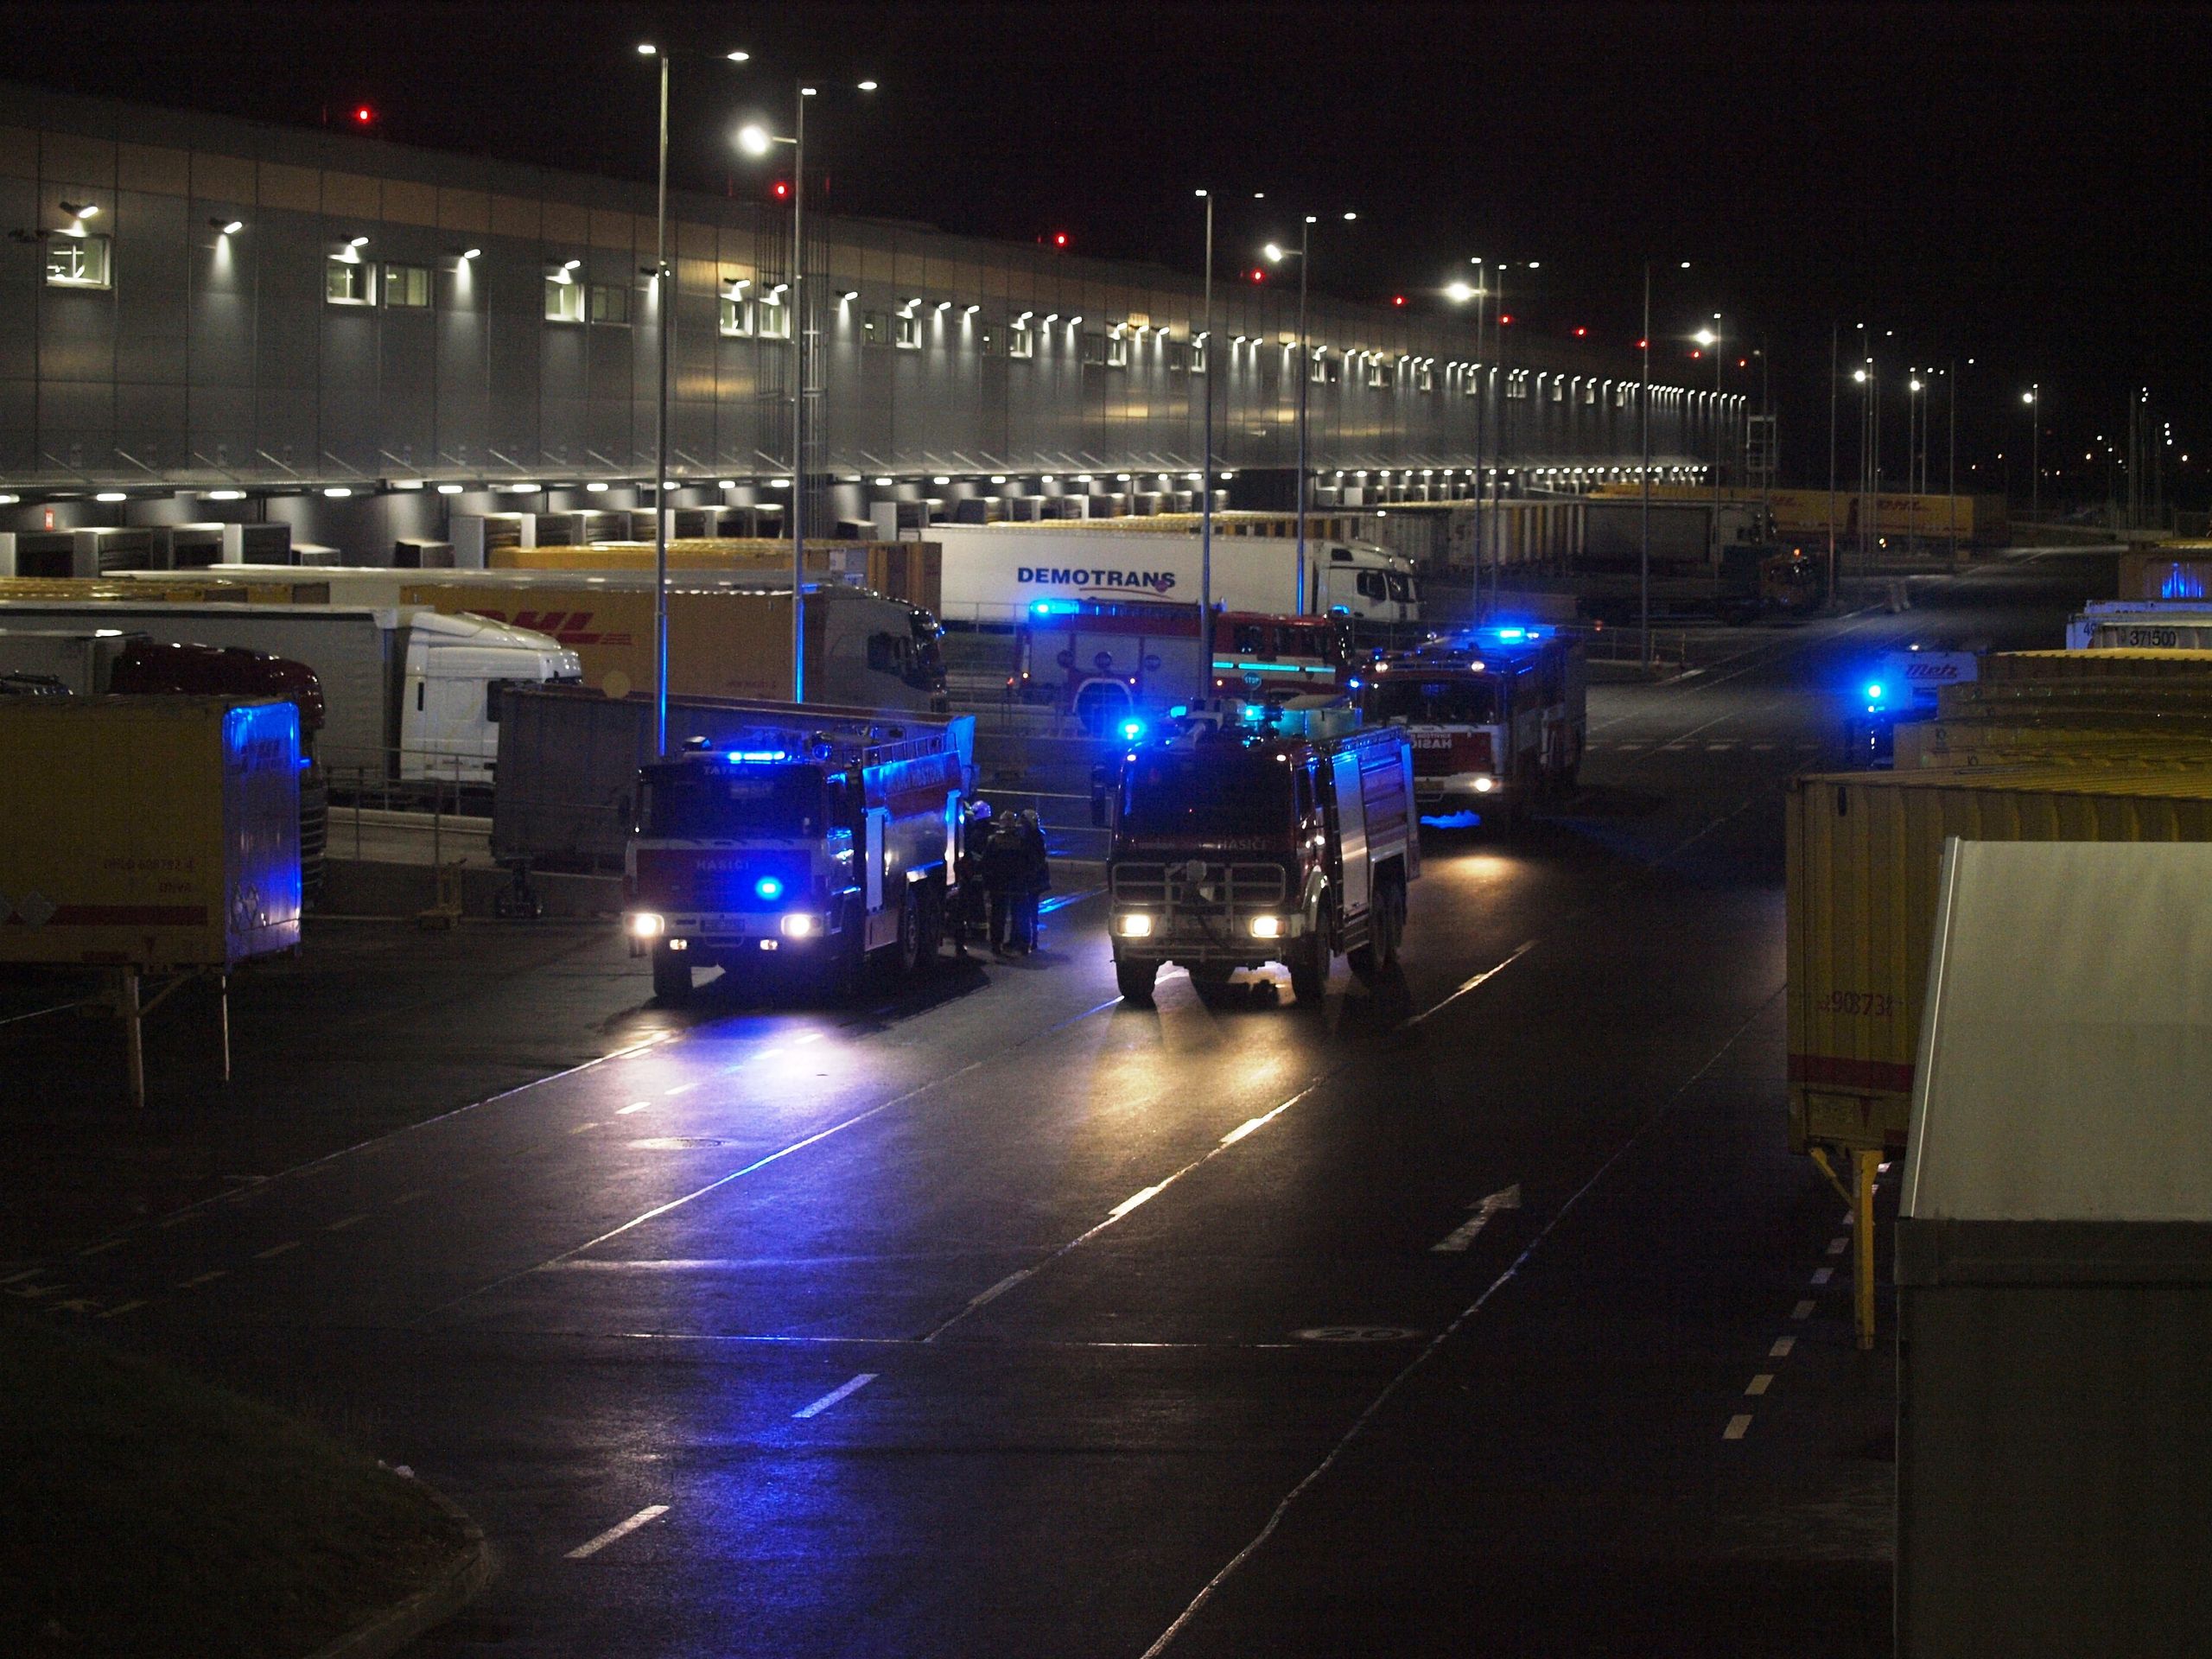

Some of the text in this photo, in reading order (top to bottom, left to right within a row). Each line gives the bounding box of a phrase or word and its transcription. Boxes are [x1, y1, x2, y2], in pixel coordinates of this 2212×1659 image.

[1017, 567, 1176, 589] DEMOTRANS
[2129, 630, 2177, 646] 371500
[703, 766, 750, 776] TATRA
